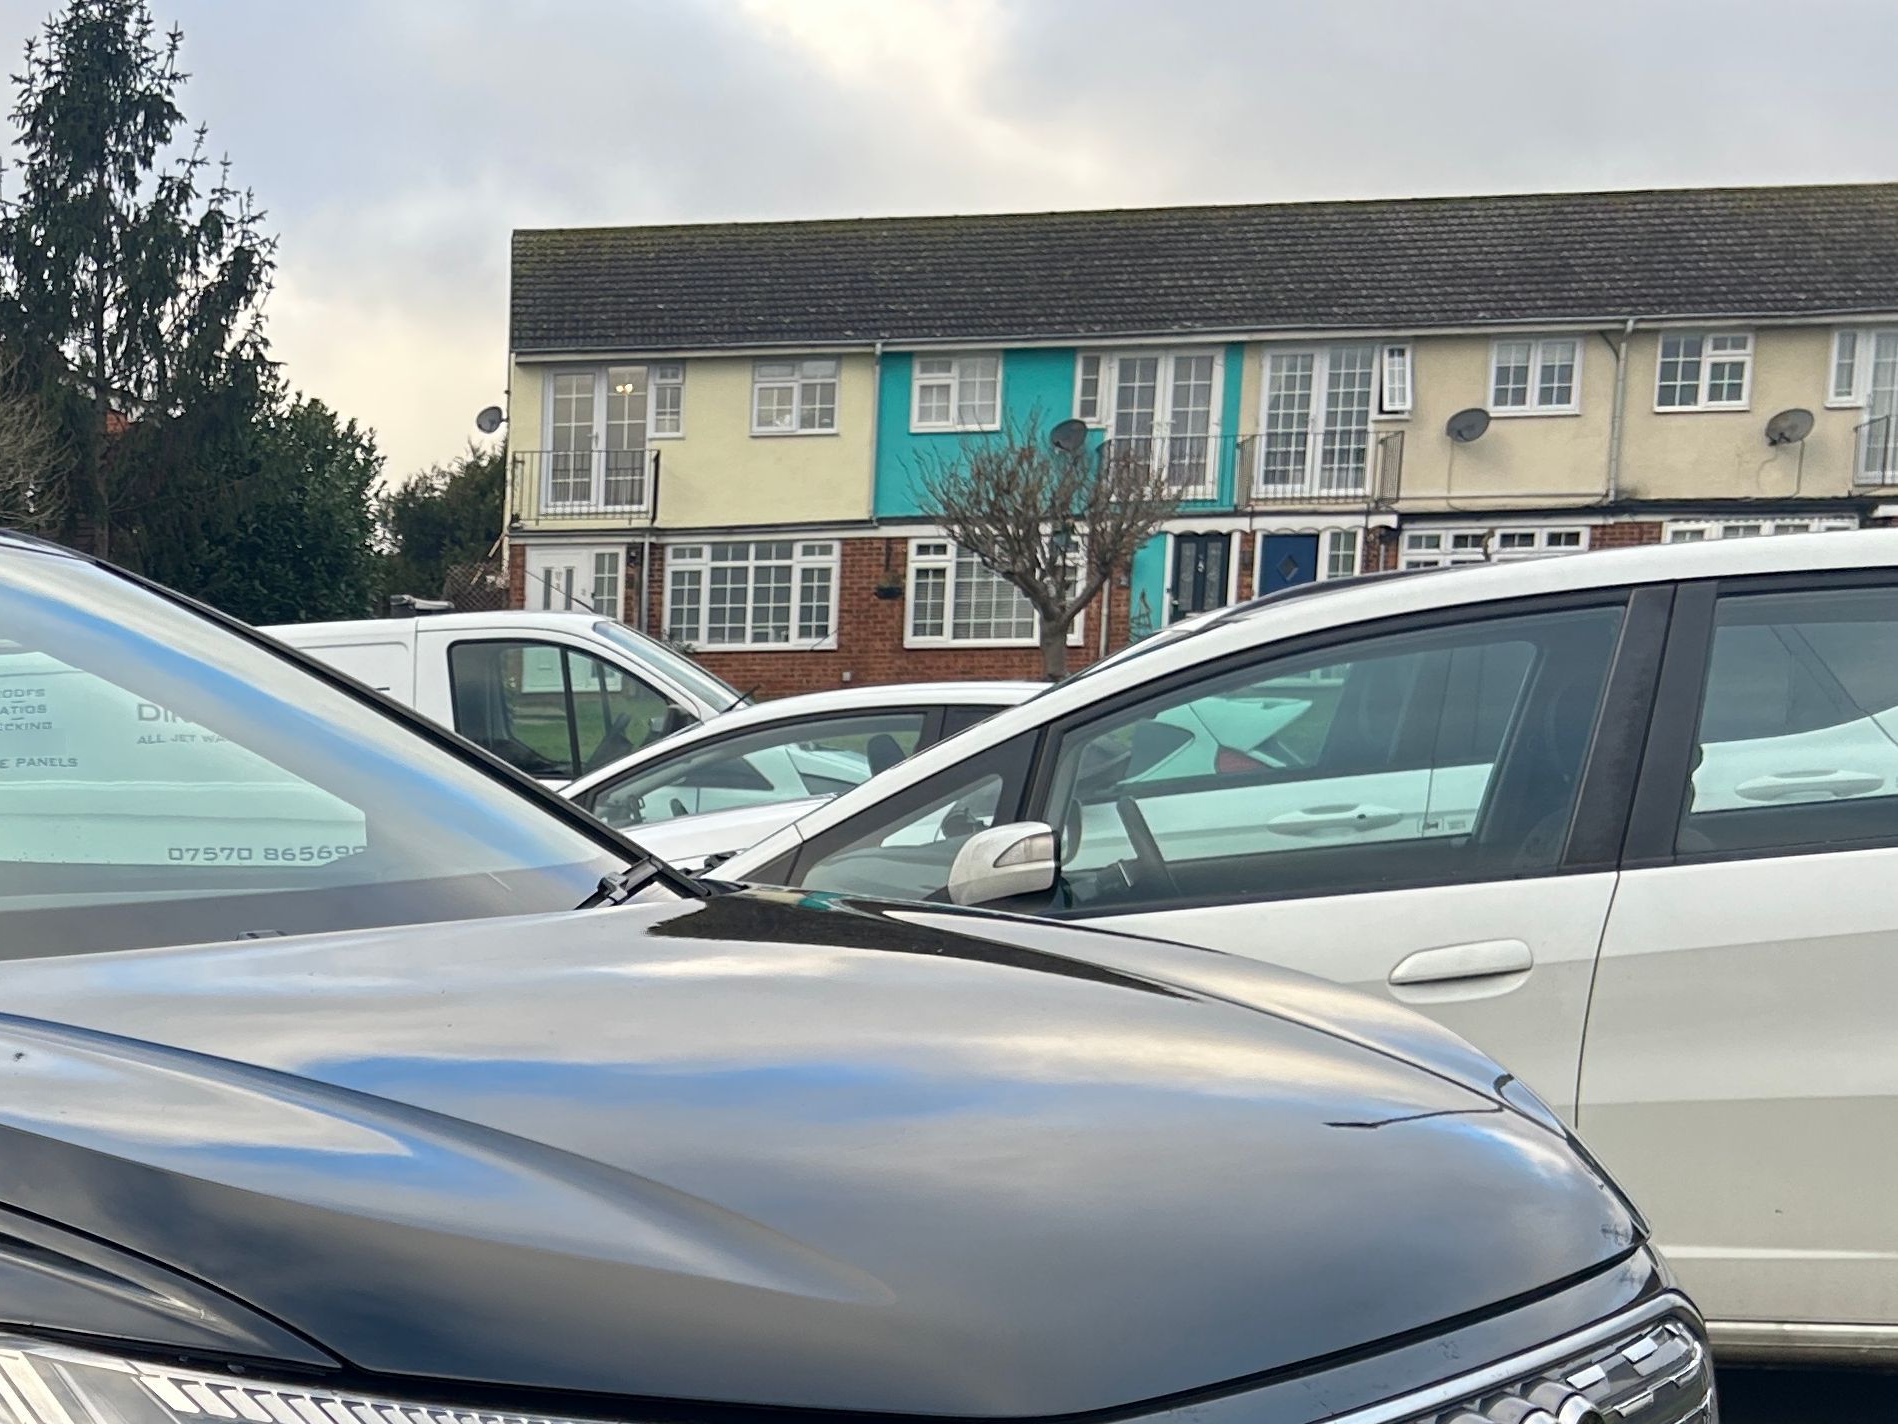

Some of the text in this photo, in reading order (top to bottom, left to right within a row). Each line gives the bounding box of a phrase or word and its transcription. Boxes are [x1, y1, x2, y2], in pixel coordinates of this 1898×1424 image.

[136, 734, 167, 745] ALL
[170, 734, 197, 743] JET
[15, 757, 79, 768] PANELS
[168, 847, 252, 862] 07570
